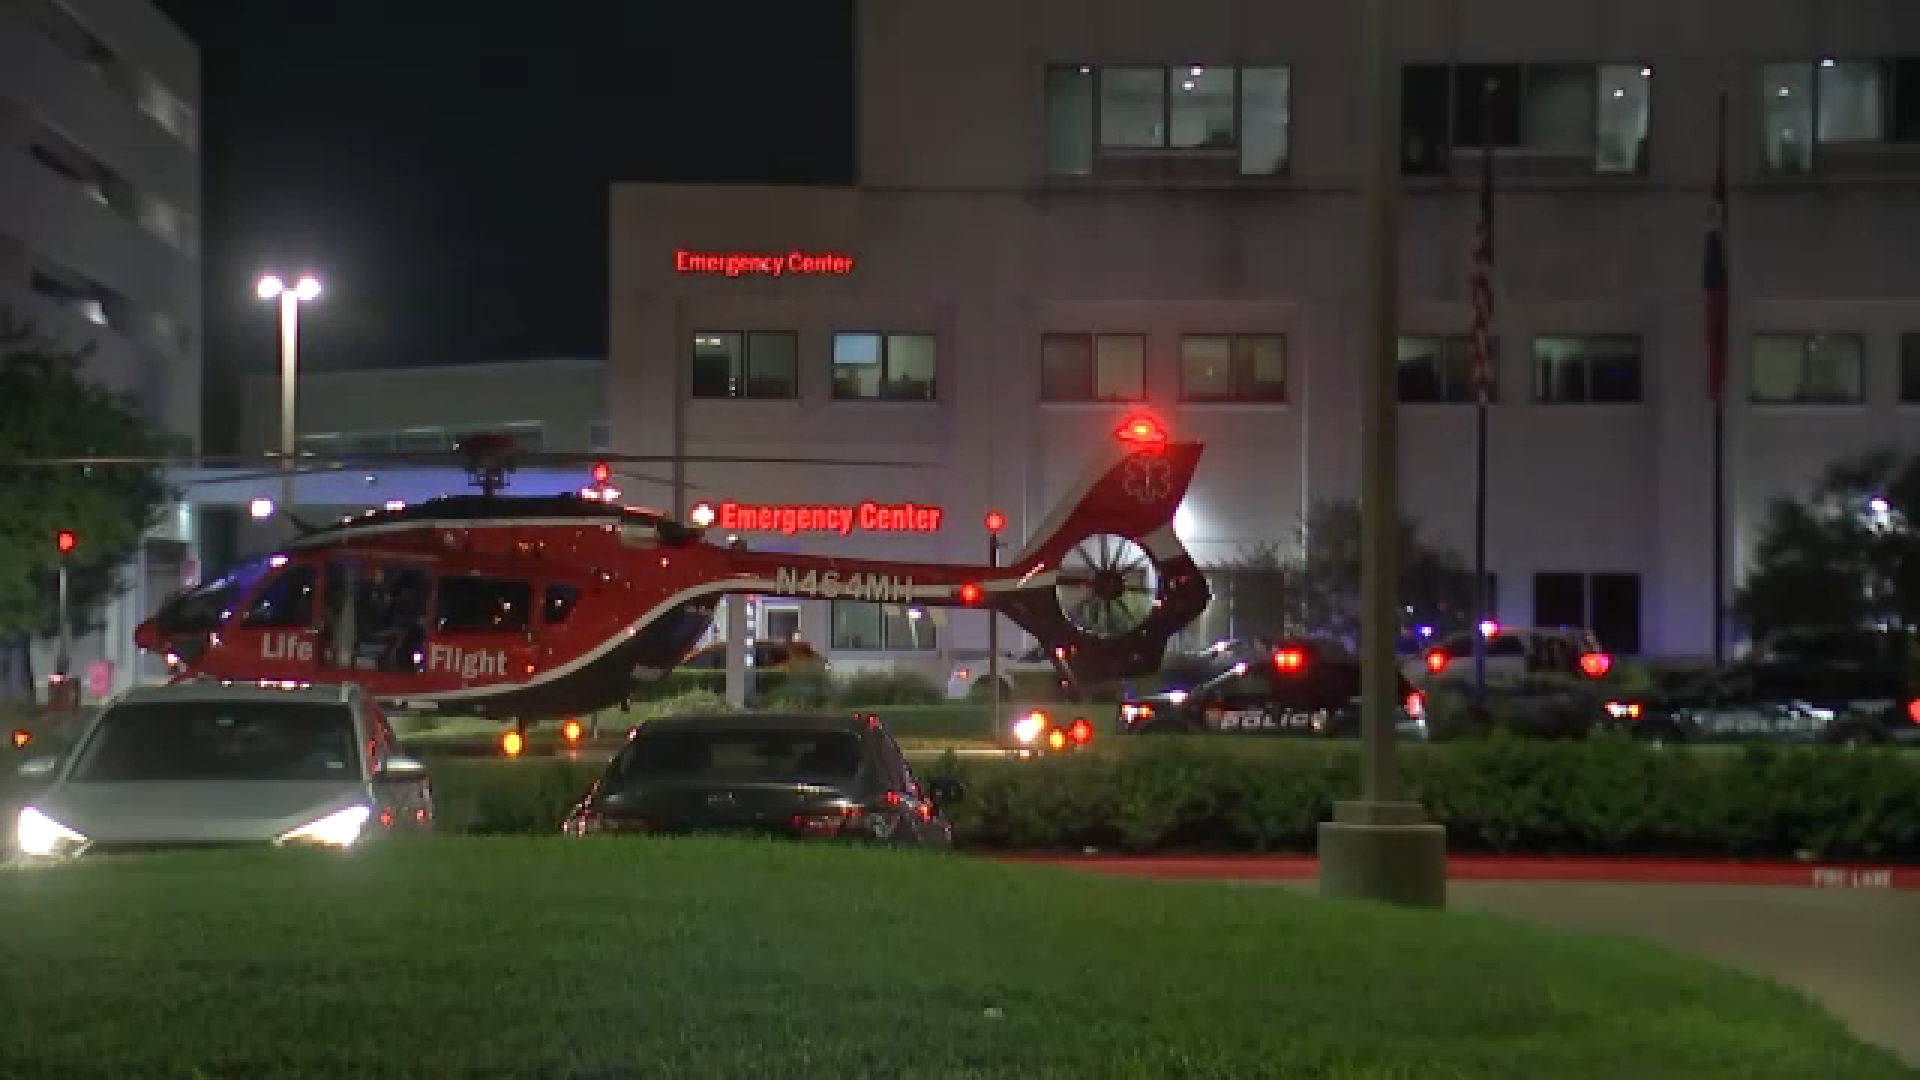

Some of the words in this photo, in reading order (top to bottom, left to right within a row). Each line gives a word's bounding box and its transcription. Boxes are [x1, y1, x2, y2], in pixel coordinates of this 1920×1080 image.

[676, 250, 784, 277] Emergency
[788, 249, 853, 272] Center
[720, 502, 853, 534] Emergency
[858, 501, 941, 531] Center
[776, 566, 913, 603] N464MH
[261, 632, 313, 661] Life
[429, 642, 508, 678] Flight
